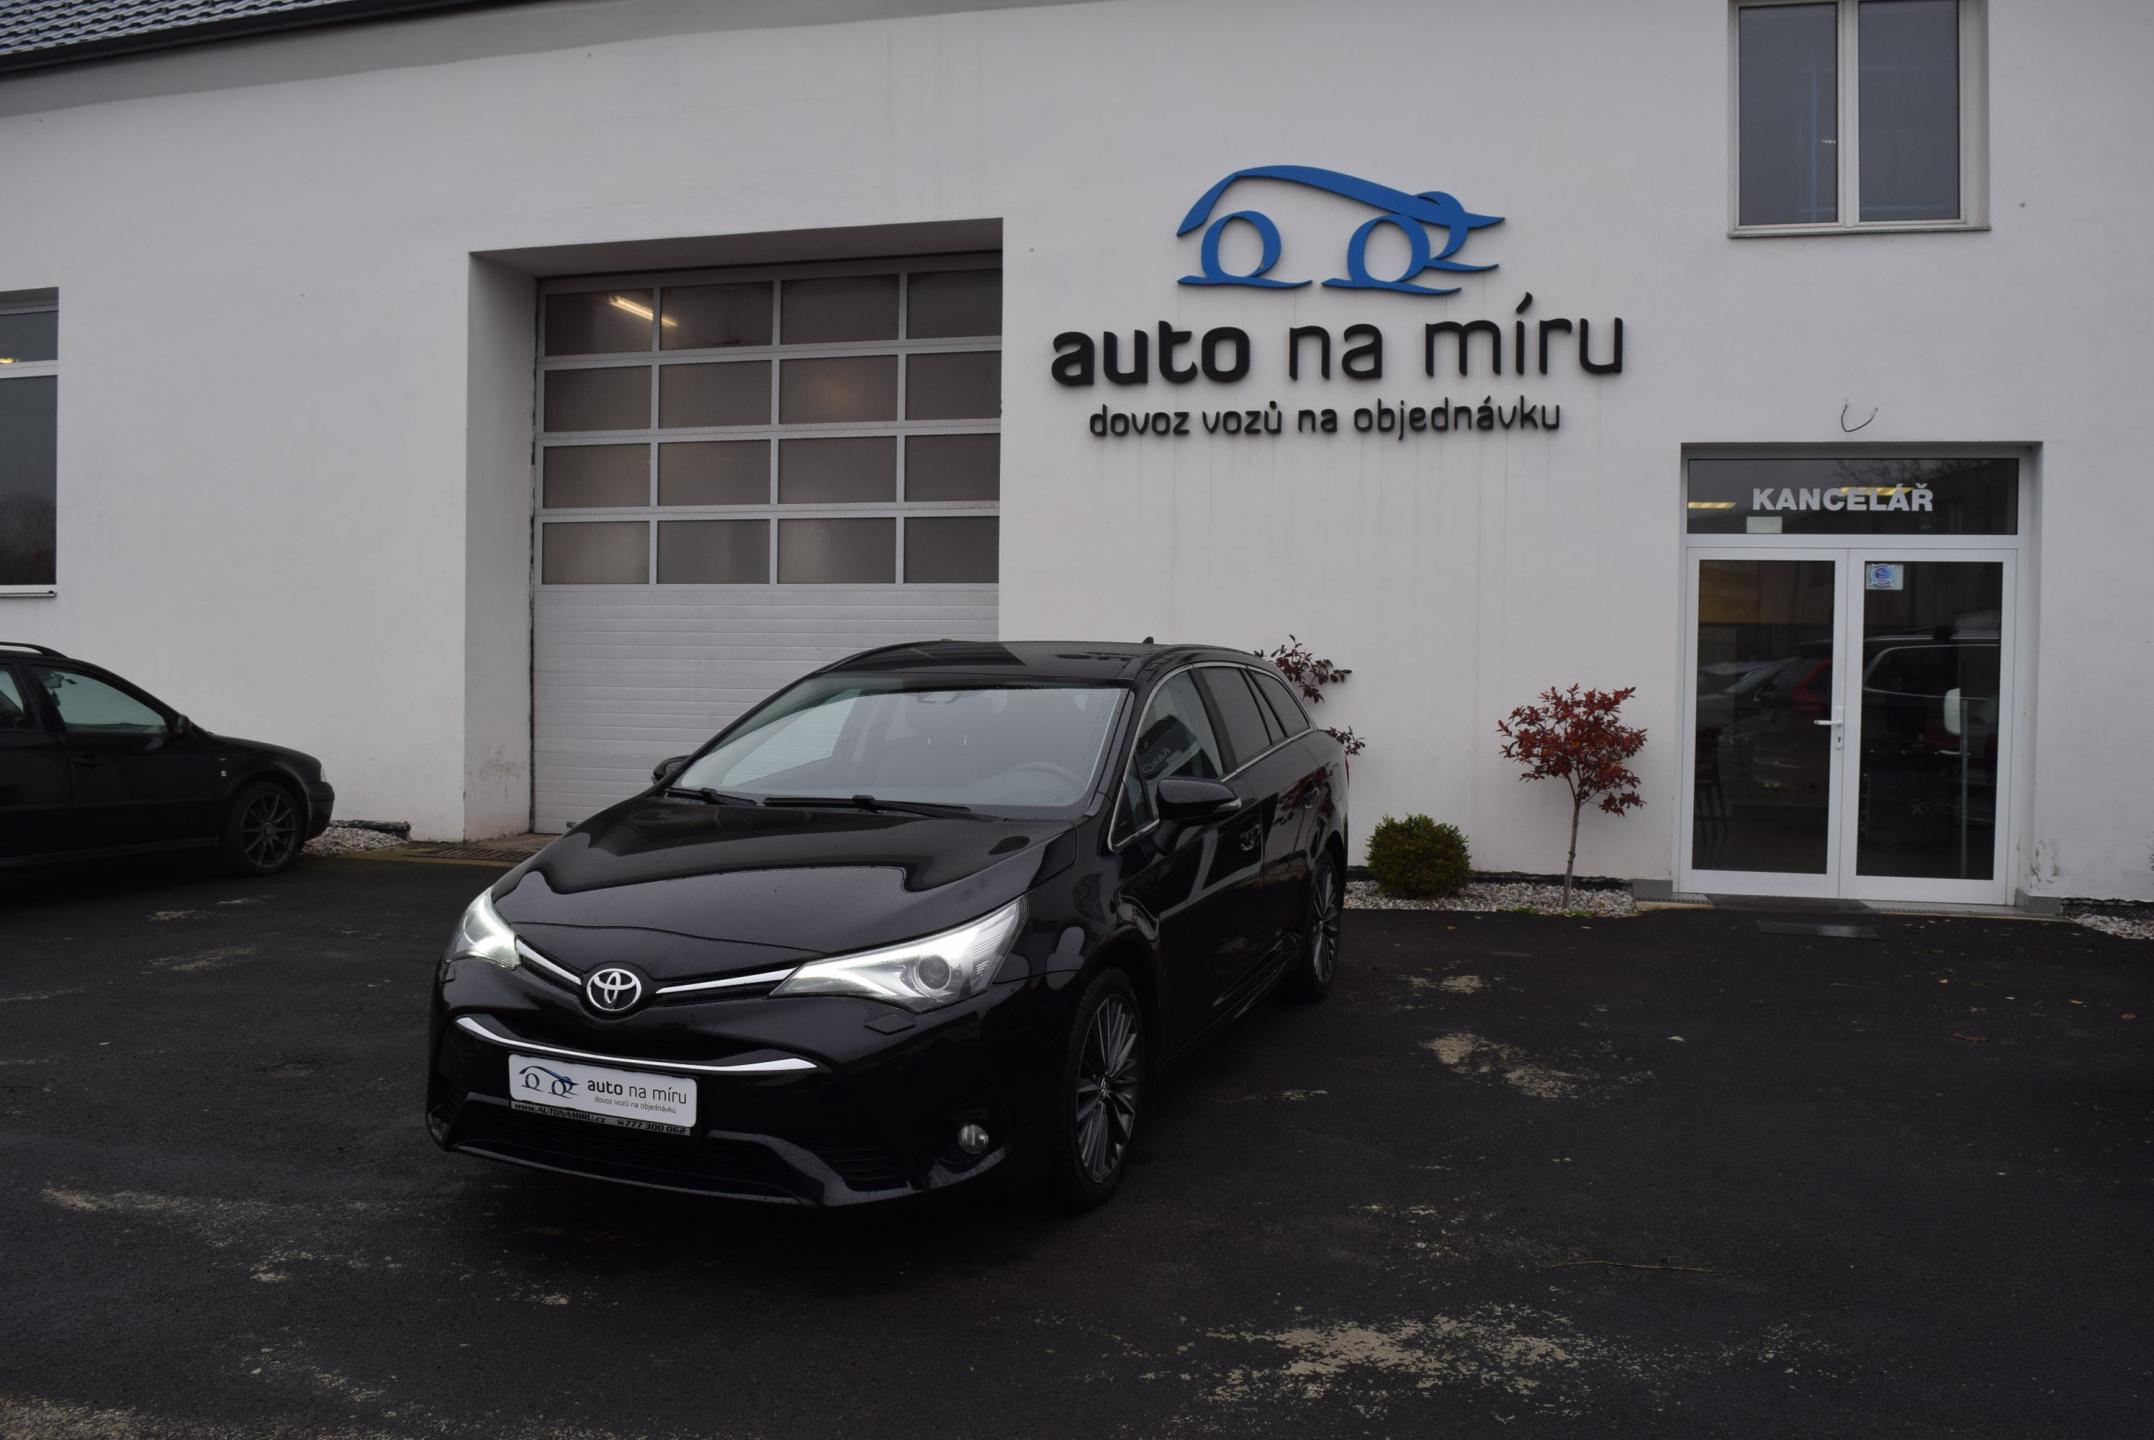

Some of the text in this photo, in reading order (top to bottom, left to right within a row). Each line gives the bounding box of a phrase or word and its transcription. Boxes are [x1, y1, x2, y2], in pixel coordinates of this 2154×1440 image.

[1051, 291, 1624, 388] auto na míru
[1089, 395, 1561, 442] dovoz vozů na objednávku
[1752, 483, 1934, 512] KANCELÁŘ
[587, 1079, 688, 1106] auto na míru
[594, 1096, 613, 1106] dovoz
